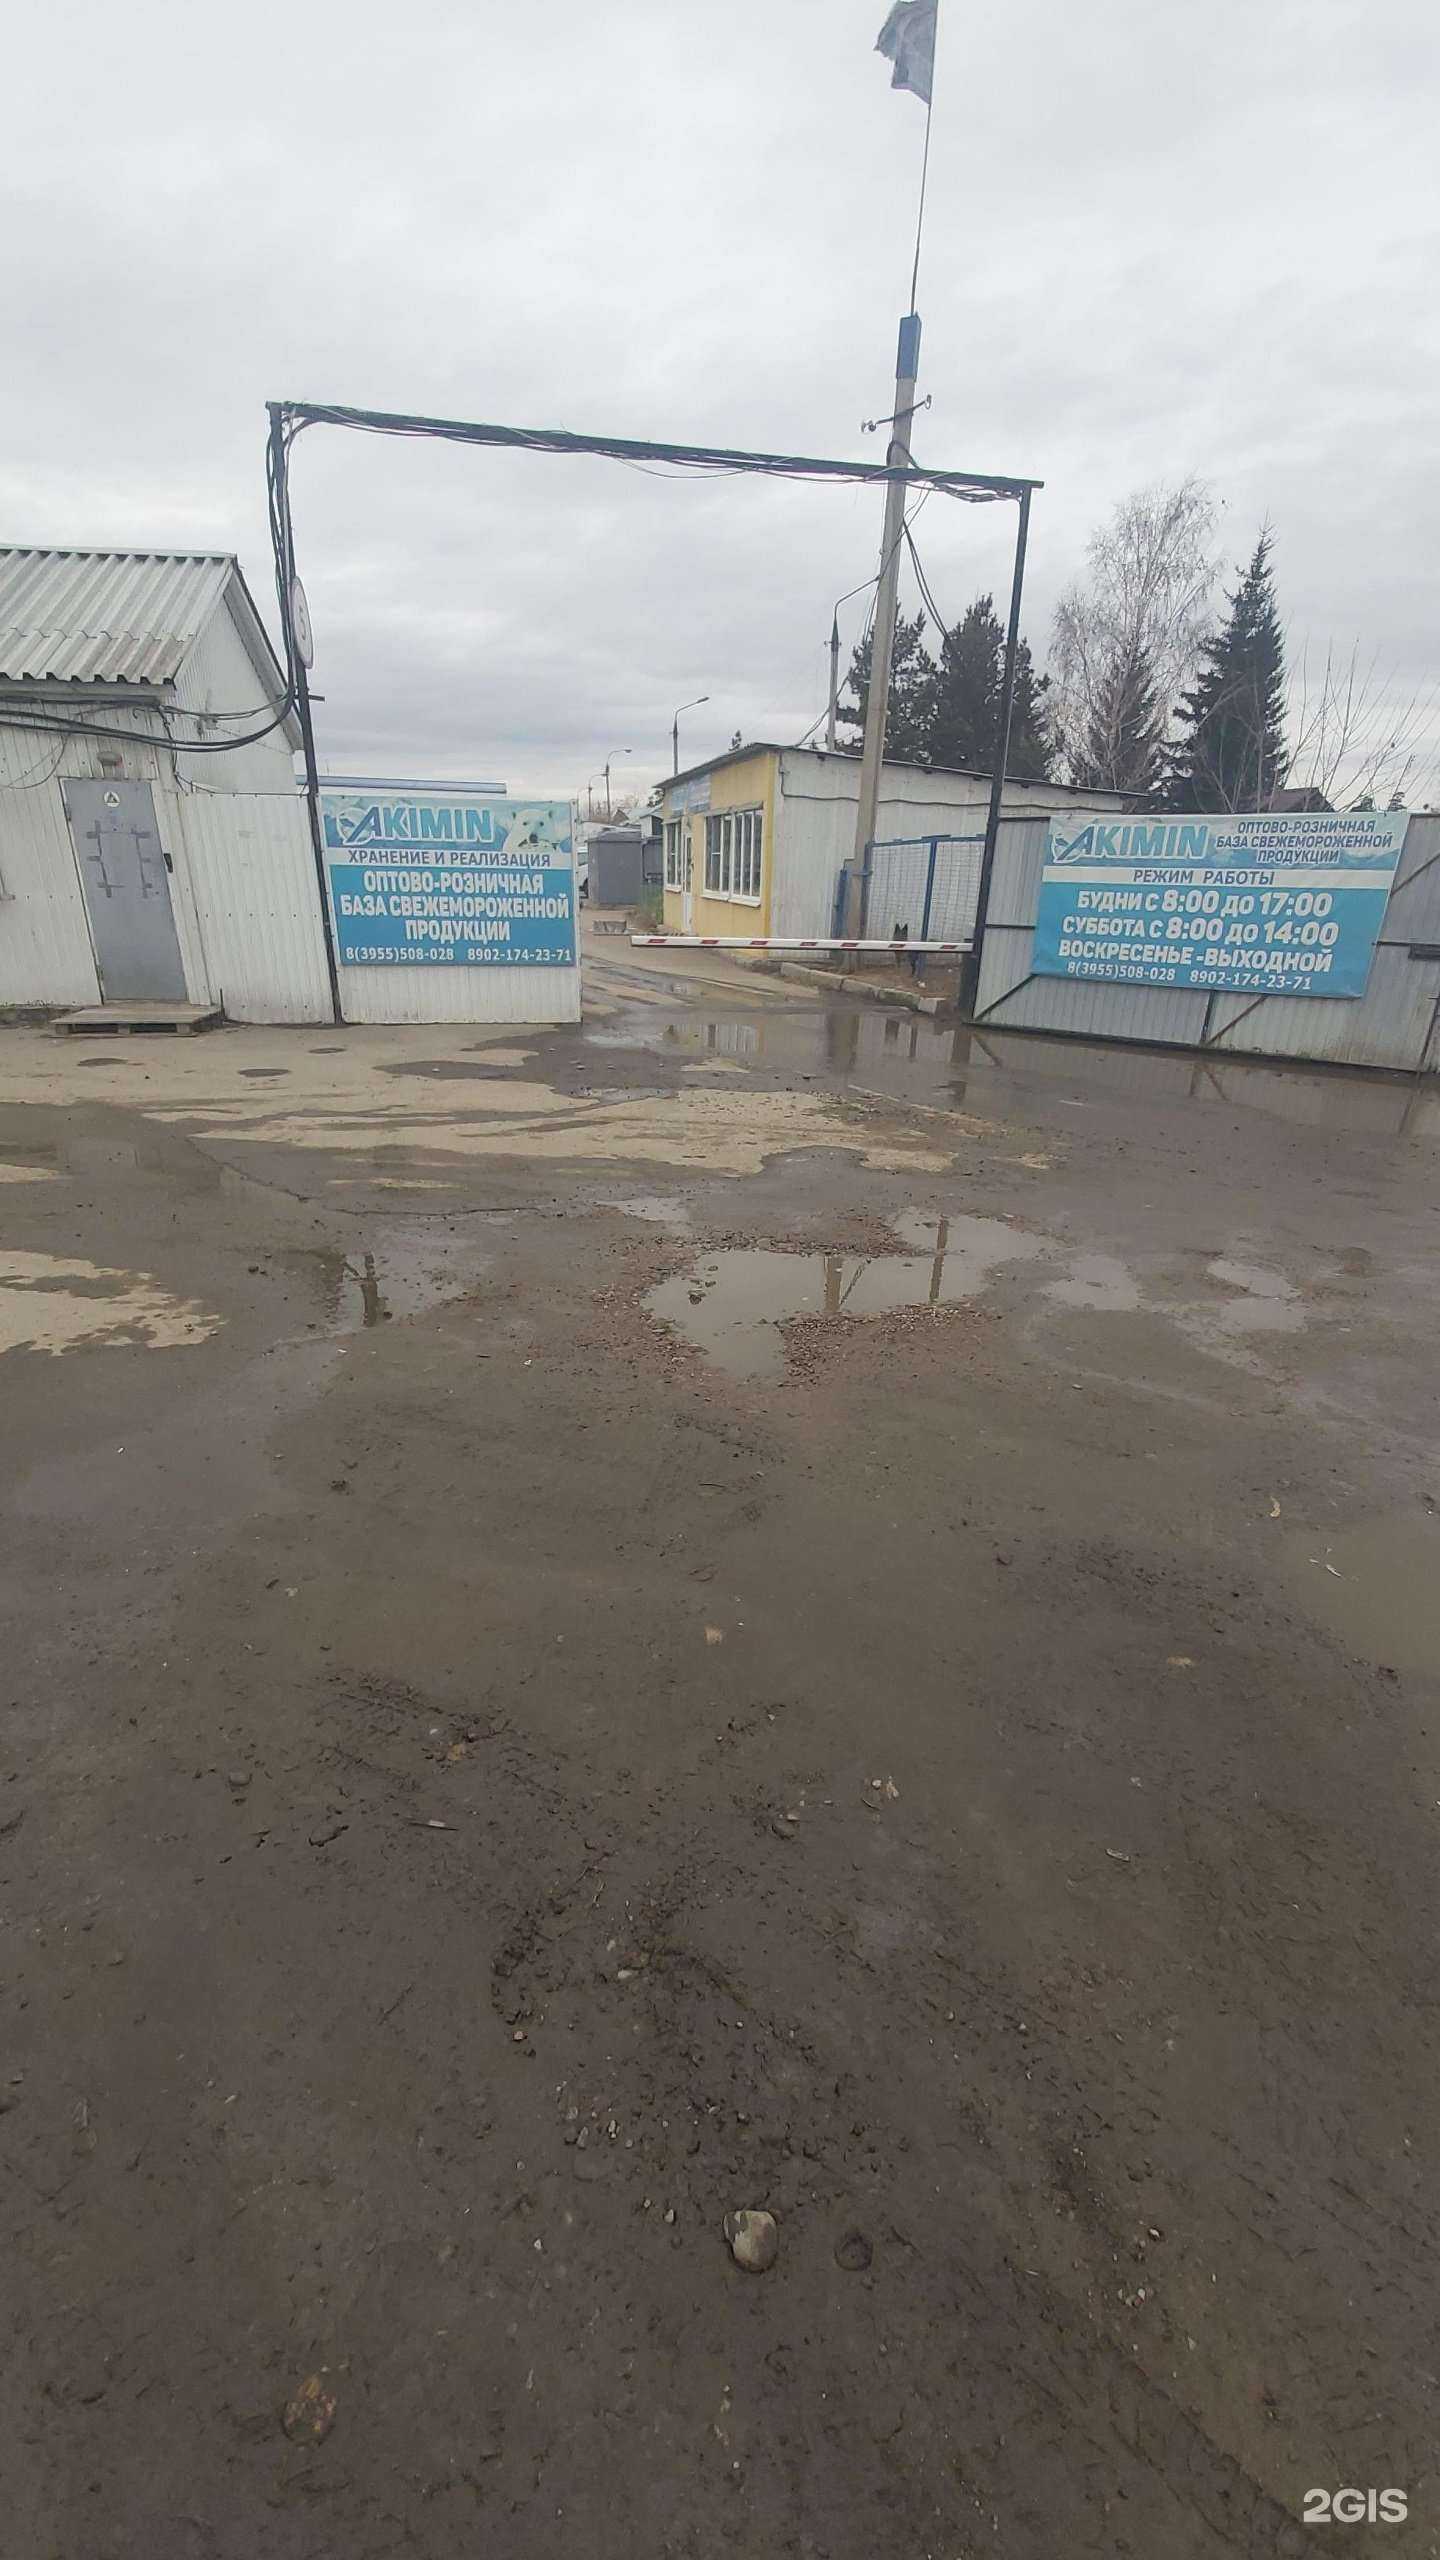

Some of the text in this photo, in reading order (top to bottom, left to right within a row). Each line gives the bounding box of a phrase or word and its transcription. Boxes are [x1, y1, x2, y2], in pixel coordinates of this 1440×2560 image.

[344, 804, 494, 844] AKIMIN
[1238, 820, 1376, 834] ОПТОВО-РОЗНИЧНАЯ
[1055, 825, 1209, 862] AKIMIN
[1216, 832, 1392, 848] БАЗА СВЕЖЕМОРОЖЕННОЙ
[348, 850, 551, 868] ХРАНЕНИЕ И РЕАЛИЗАЦИЯ
[1257, 850, 1340, 864] ПРОДУКЦИИ
[364, 871, 544, 894] ОПТОВО-РОЗНИЧНАЯ
[1133, 869, 1275, 885] РЕЖИМ РАБОТЫ
[340, 893, 569, 919] БАЗА СВЕЖЕМОРОЖЕННОЙ
[1077, 890, 1142, 913] БУДНИ
[1161, 889, 1220, 914] 8:00
[1259, 892, 1333, 917] 17:00
[405, 919, 511, 945] ПРОДУКЦИИ
[1062, 916, 1146, 937] СУББОТА
[1165, 916, 1223, 941] 8:00
[1263, 920, 1339, 946] 14:00
[346, 946, 571, 962] 8(3955)508-028 8902-174-23-71
[1058, 939, 1194, 965] ВОСКРЕСЕНЬЕ
[1067, 961, 1312, 990] 8(3955)508-028 8902-174-23-71
